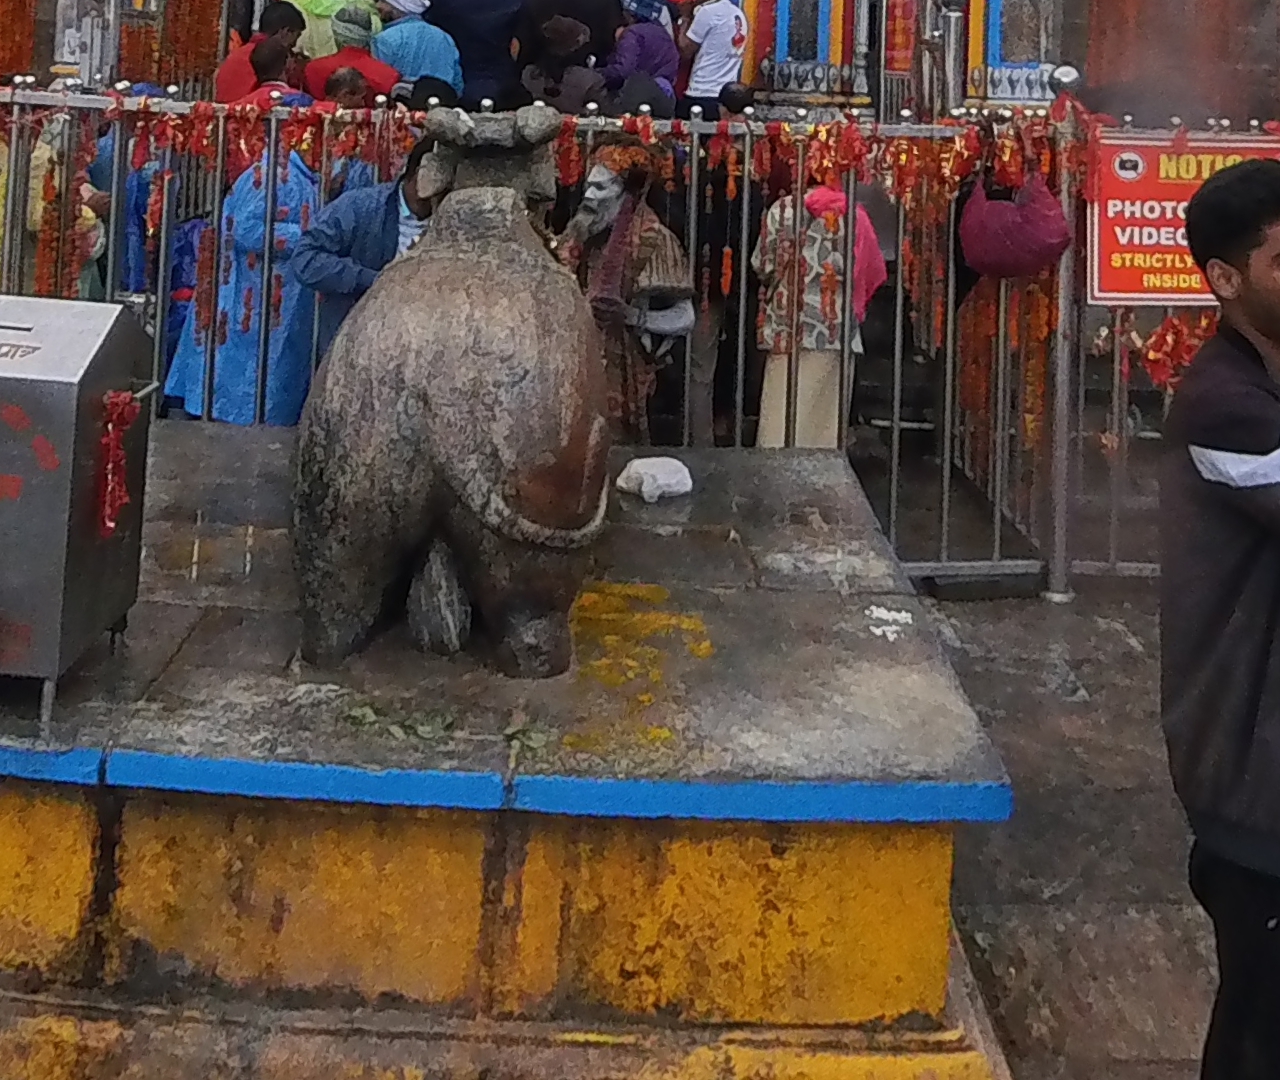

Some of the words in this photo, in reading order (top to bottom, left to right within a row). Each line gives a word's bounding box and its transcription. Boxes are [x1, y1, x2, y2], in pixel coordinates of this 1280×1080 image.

[1158, 153, 1244, 180] NOTI
[1110, 252, 1195, 269] STRICTLY
[1142, 273, 1202, 289] INSIDE
